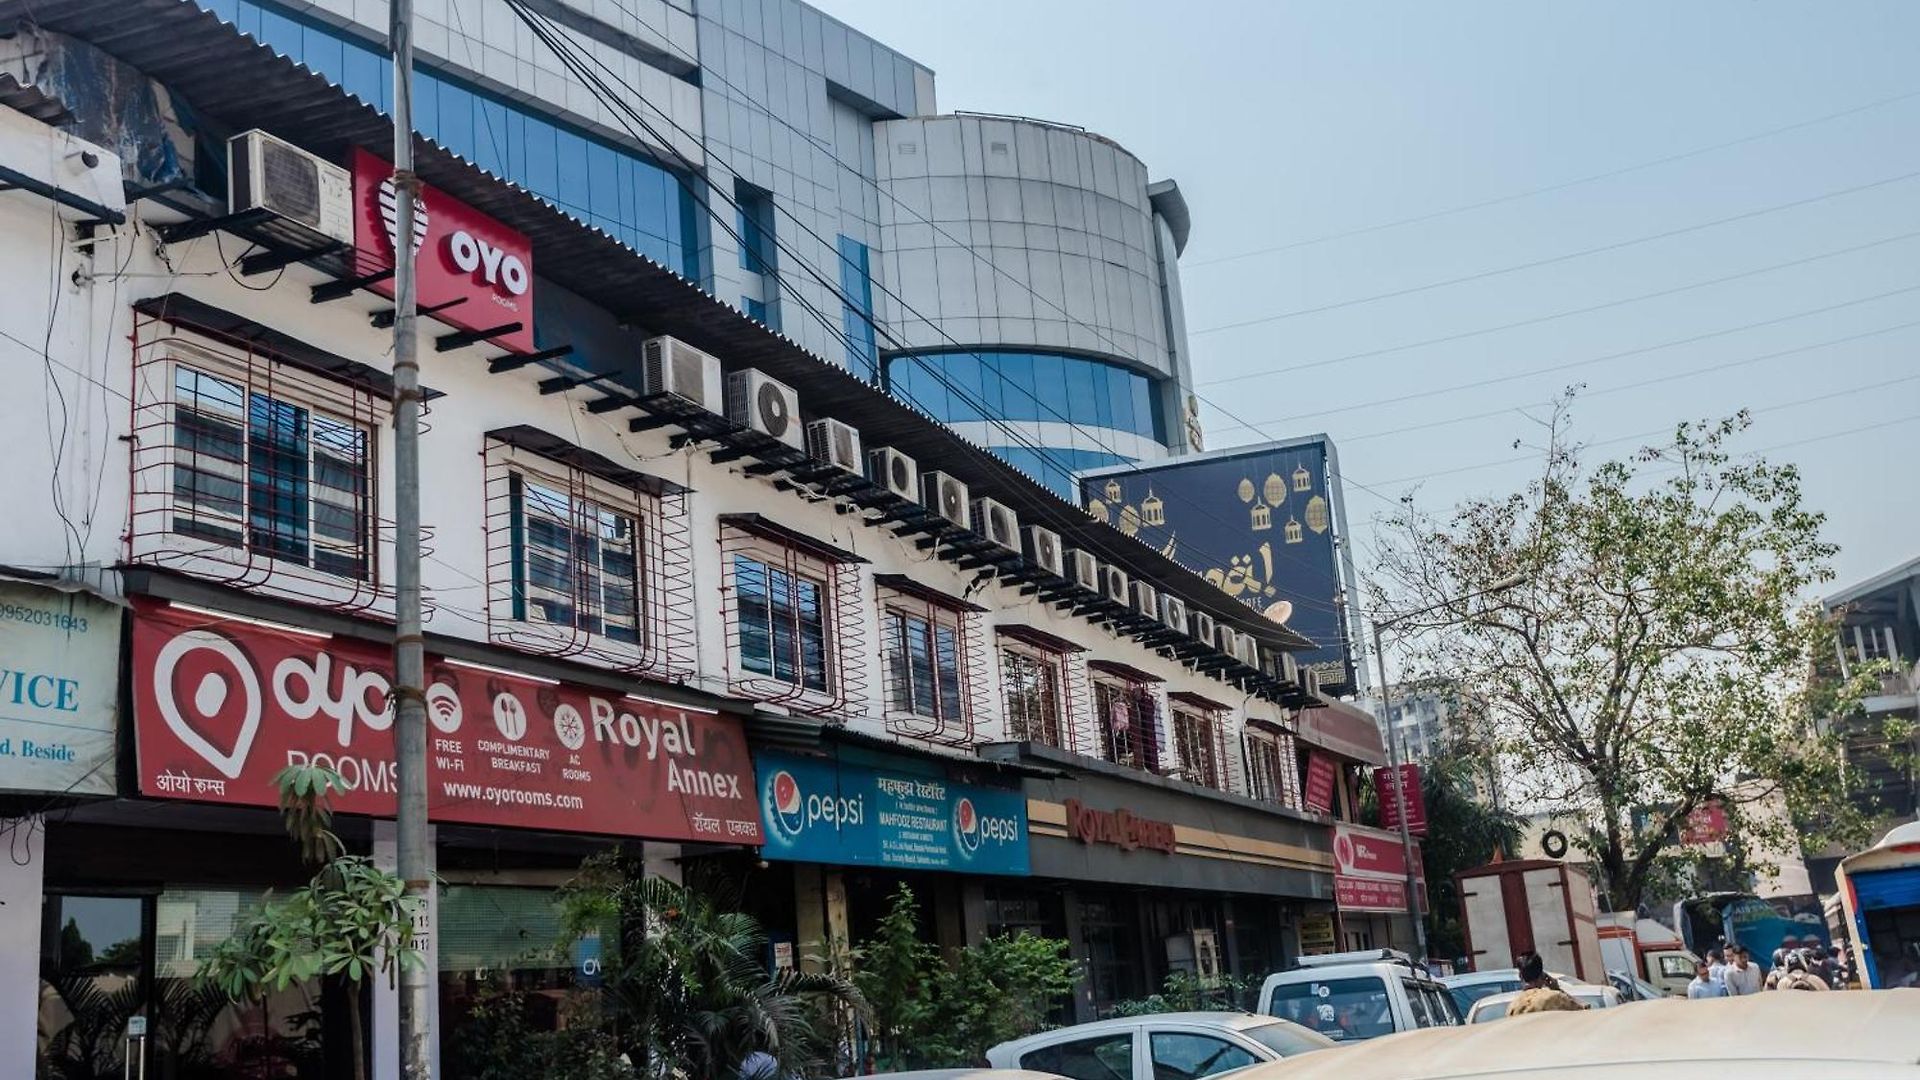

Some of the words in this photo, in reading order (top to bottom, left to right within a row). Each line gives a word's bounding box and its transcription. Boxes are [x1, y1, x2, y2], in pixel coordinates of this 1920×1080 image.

[451, 230, 528, 295] OYO
[22, 739, 76, 762] Beside
[435, 738, 463, 753] FREE
[477, 740, 551, 760] COMPLIMENTARY
[589, 696, 696, 760] Royal
[668, 758, 742, 799] Annex
[436, 756, 465, 771] WI-FI
[491, 757, 542, 774] BREAKFAST
[569, 754, 581, 765] AC
[156, 769, 191, 793] ओयो
[562, 768, 592, 782] ROOMS
[443, 782, 584, 809] www.oyorooms.com
[808, 793, 864, 831] pepsi
[981, 815, 1019, 846] pepsi
